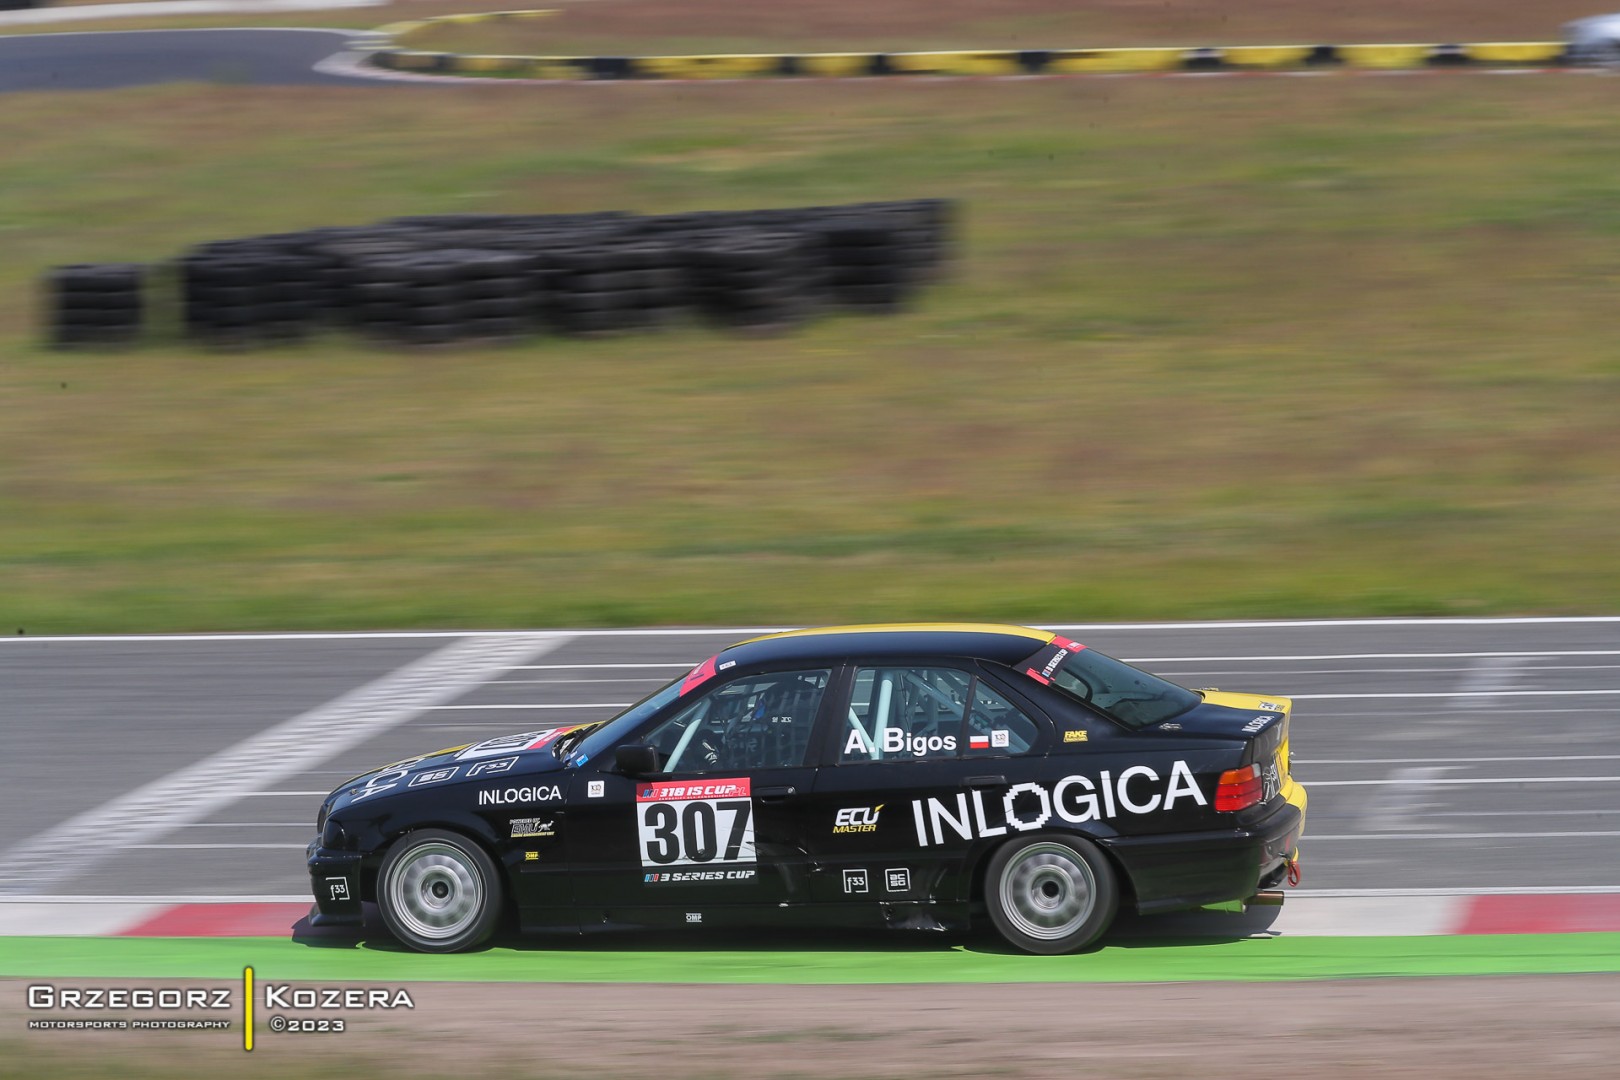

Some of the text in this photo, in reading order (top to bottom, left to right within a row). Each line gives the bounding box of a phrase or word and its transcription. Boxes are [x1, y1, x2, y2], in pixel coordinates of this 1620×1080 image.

[1064, 730, 1088, 738] FAKE
[844, 727, 957, 758] A. Bigos
[478, 785, 562, 805] INLOGICA
[659, 787, 685, 797] 318
[686, 786, 704, 796] IS
[705, 784, 737, 796] CUP
[912, 759, 1208, 847] INLOGICA
[835, 806, 881, 827] ECU
[644, 800, 752, 864] 307
[833, 824, 877, 833] MASTER
[660, 870, 756, 882] 3 SERIES CUP
[685, 912, 702, 922] OMP
